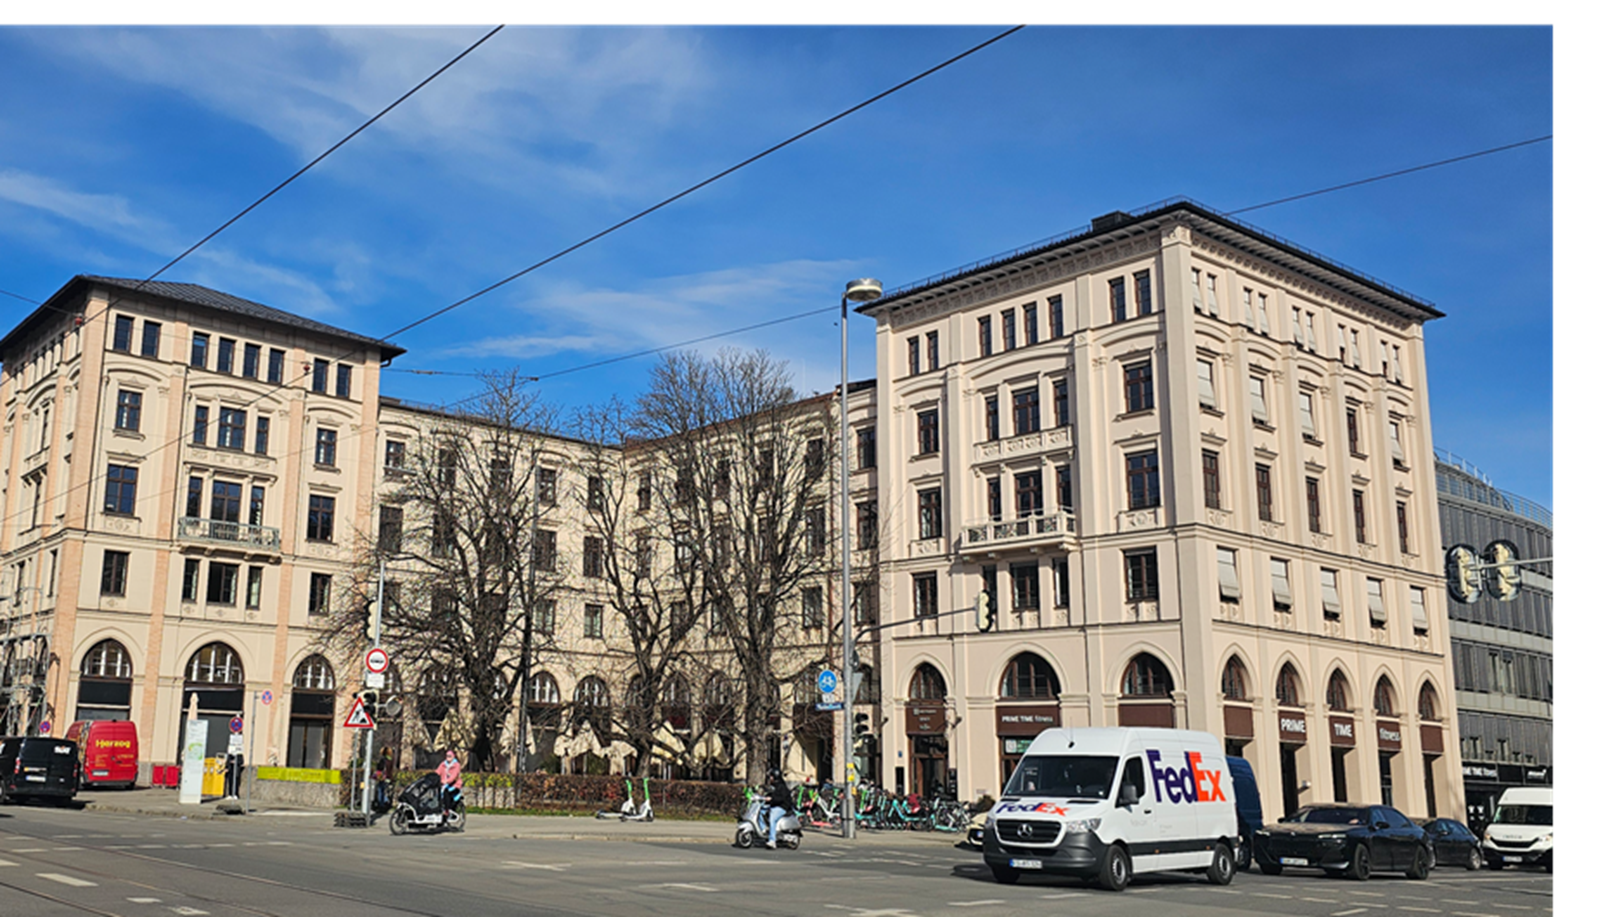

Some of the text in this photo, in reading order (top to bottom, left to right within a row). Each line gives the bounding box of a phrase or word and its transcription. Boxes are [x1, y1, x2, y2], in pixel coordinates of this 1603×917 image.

[1280, 718, 1306, 733] PRIME
[1333, 723, 1353, 738] TIME
[95, 739, 131, 749] Herzog
[1145, 749, 1227, 804] FedEx
[996, 802, 1071, 817] FedEx
